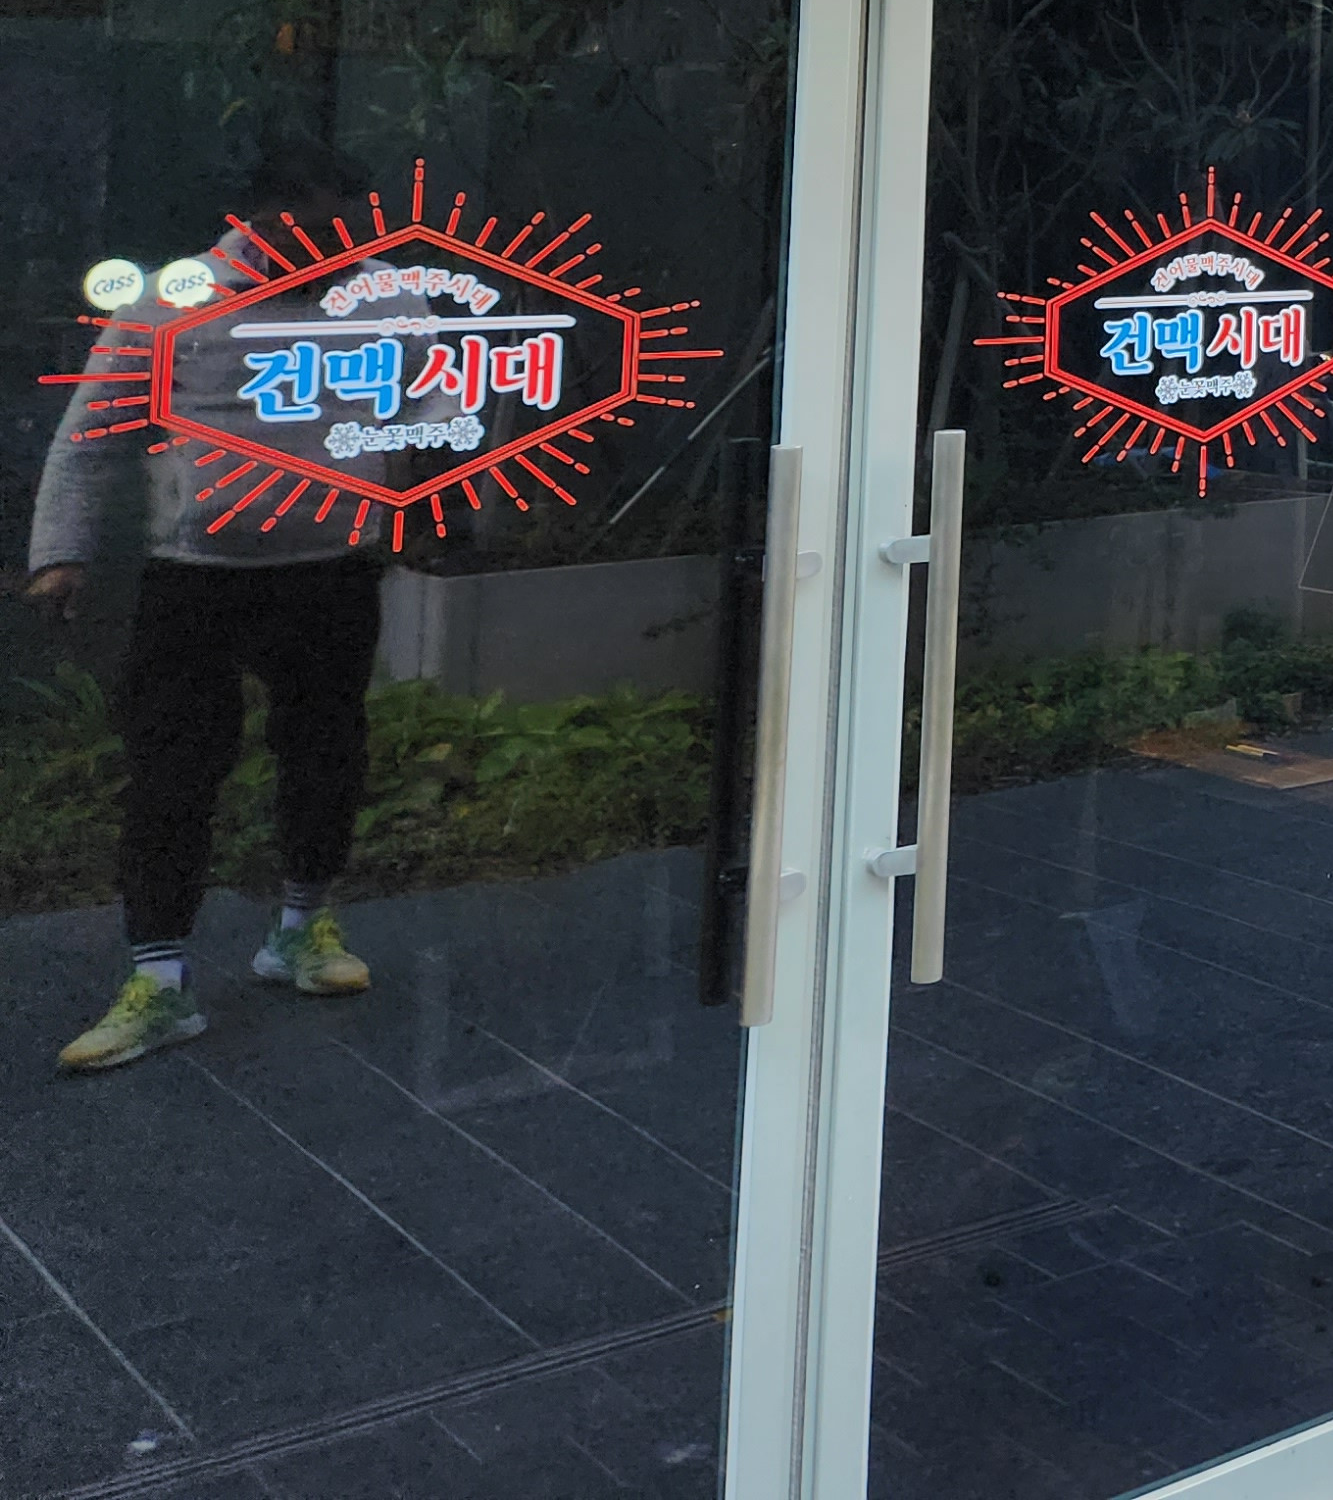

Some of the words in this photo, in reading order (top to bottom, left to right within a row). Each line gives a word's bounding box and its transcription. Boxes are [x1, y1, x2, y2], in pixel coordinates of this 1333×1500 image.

[1099, 304, 1306, 376] 건맥시대
[236, 333, 563, 423] 건맥시대
[362, 422, 448, 450] 눈꽃맥주
